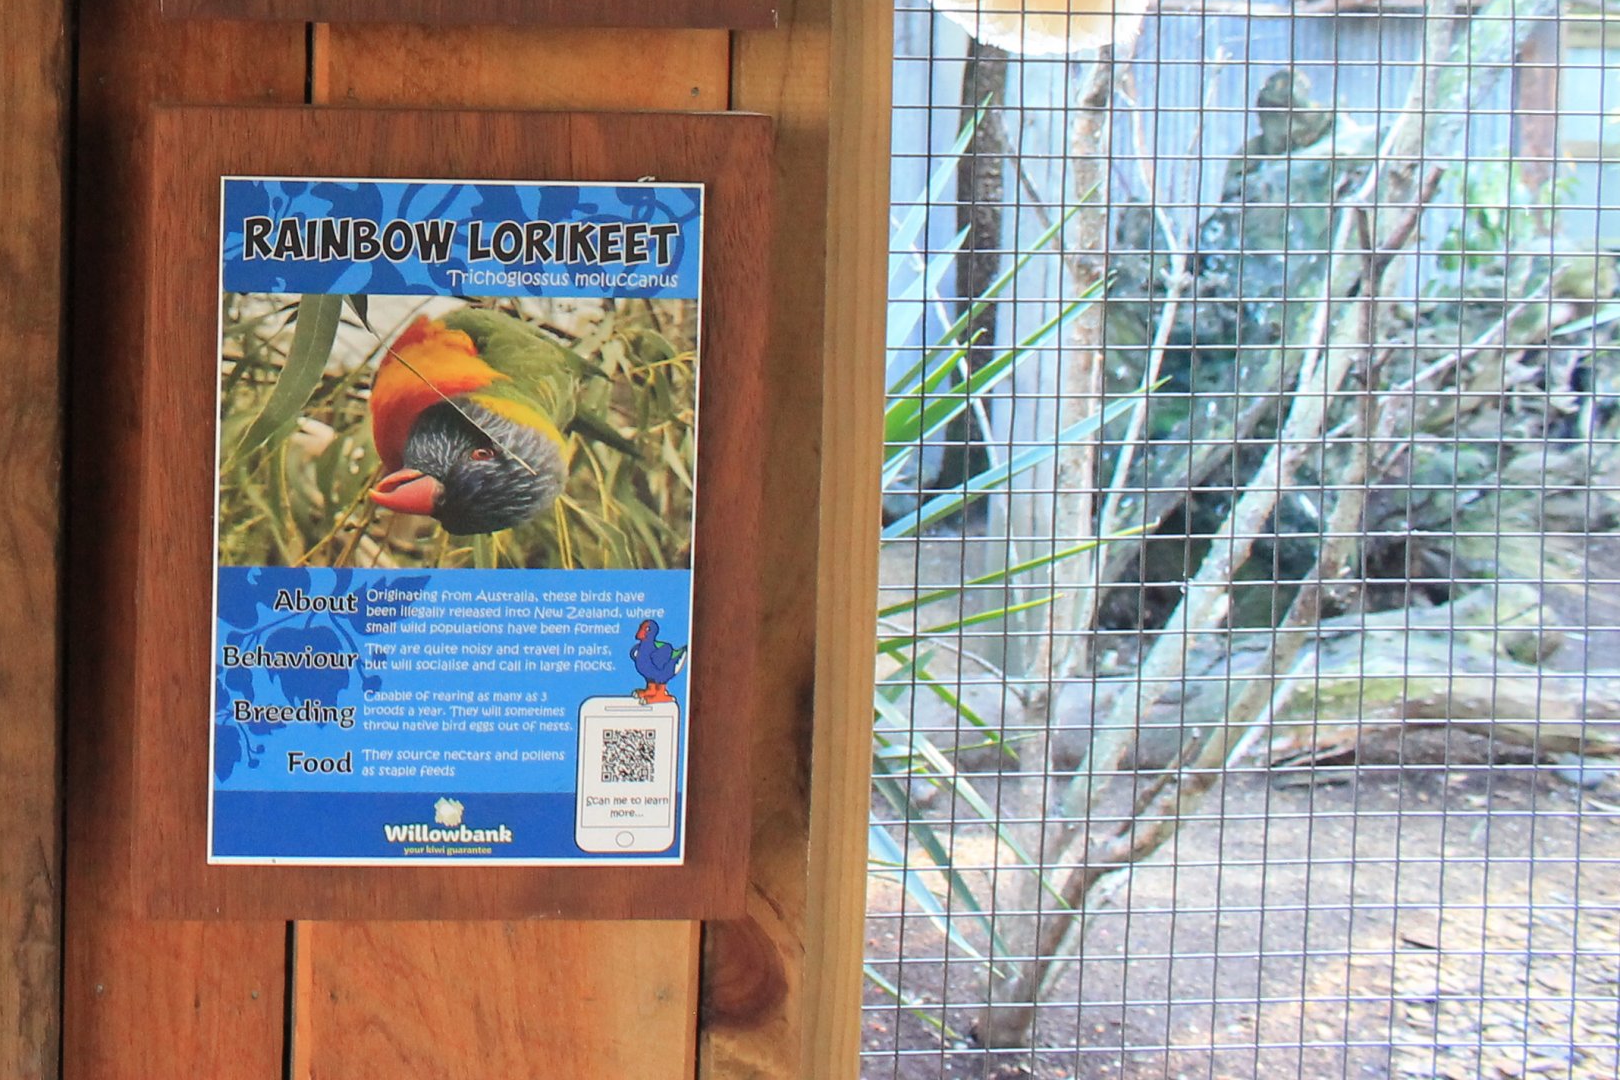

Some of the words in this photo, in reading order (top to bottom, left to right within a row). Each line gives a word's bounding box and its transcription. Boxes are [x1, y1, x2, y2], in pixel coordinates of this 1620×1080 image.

[242, 215, 457, 265] RAINBOW
[467, 218, 680, 267] LORIKEET
[446, 268, 569, 288] Trichoglossus
[574, 271, 678, 288] moluccanus
[273, 587, 359, 614] About
[366, 589, 438, 602] Originating
[440, 590, 472, 602] from
[475, 590, 539, 603] Australia,
[542, 590, 578, 602] these
[580, 590, 612, 602] birds
[615, 590, 645, 602] have
[365, 606, 396, 618] been
[399, 606, 446, 619] illegally
[449, 606, 501, 618] released
[504, 607, 531, 618] into
[534, 606, 564, 619] New
[566, 606, 623, 619] Zealand,
[626, 607, 665, 619] where
[365, 622, 396, 634] small
[399, 622, 426, 634] wild
[429, 622, 504, 635] populations
[507, 623, 537, 634] have
[540, 623, 571, 634] been
[573, 623, 620, 635] formed
[222, 644, 359, 670] Behaviour
[233, 699, 356, 729] Breeding
[286, 751, 354, 775] Food
[361, 748, 393, 762] They
[396, 750, 440, 761] source
[443, 749, 492, 762] nectars
[494, 750, 519, 762] and
[521, 749, 565, 762] pollens
[586, 795, 611, 807] Scan
[613, 797, 628, 806] me
[630, 796, 642, 806] to
[644, 795, 669, 806] learn
[609, 808, 644, 819] more...
[383, 824, 513, 844] Willowbank
[403, 845, 425, 855] your
[425, 844, 446, 854] kiwi
[446, 845, 492, 855] guarantee
